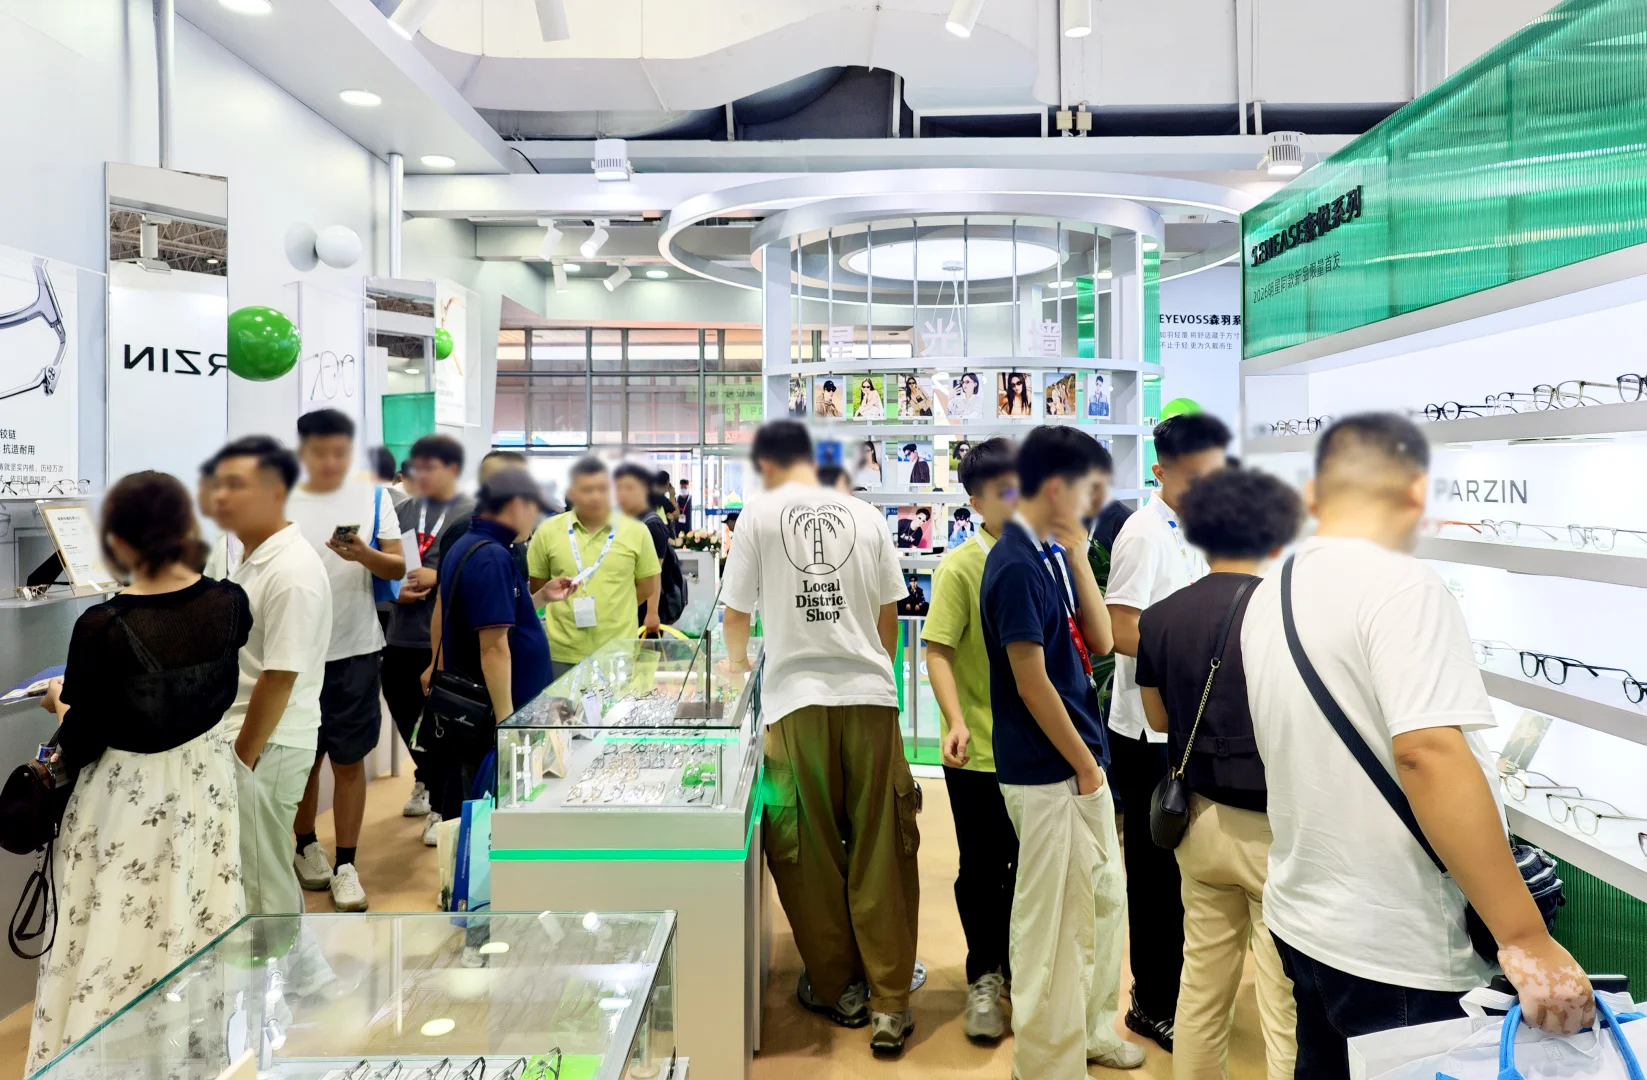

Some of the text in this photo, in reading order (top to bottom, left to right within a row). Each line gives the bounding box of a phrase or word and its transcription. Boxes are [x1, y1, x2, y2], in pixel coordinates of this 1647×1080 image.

[3, 443, 35, 455] 抗造耐用
[1434, 479, 1527, 504] PARZIN
[802, 579, 840, 593] Local
[795, 594, 846, 608] Distric
[806, 608, 840, 623] Shop
